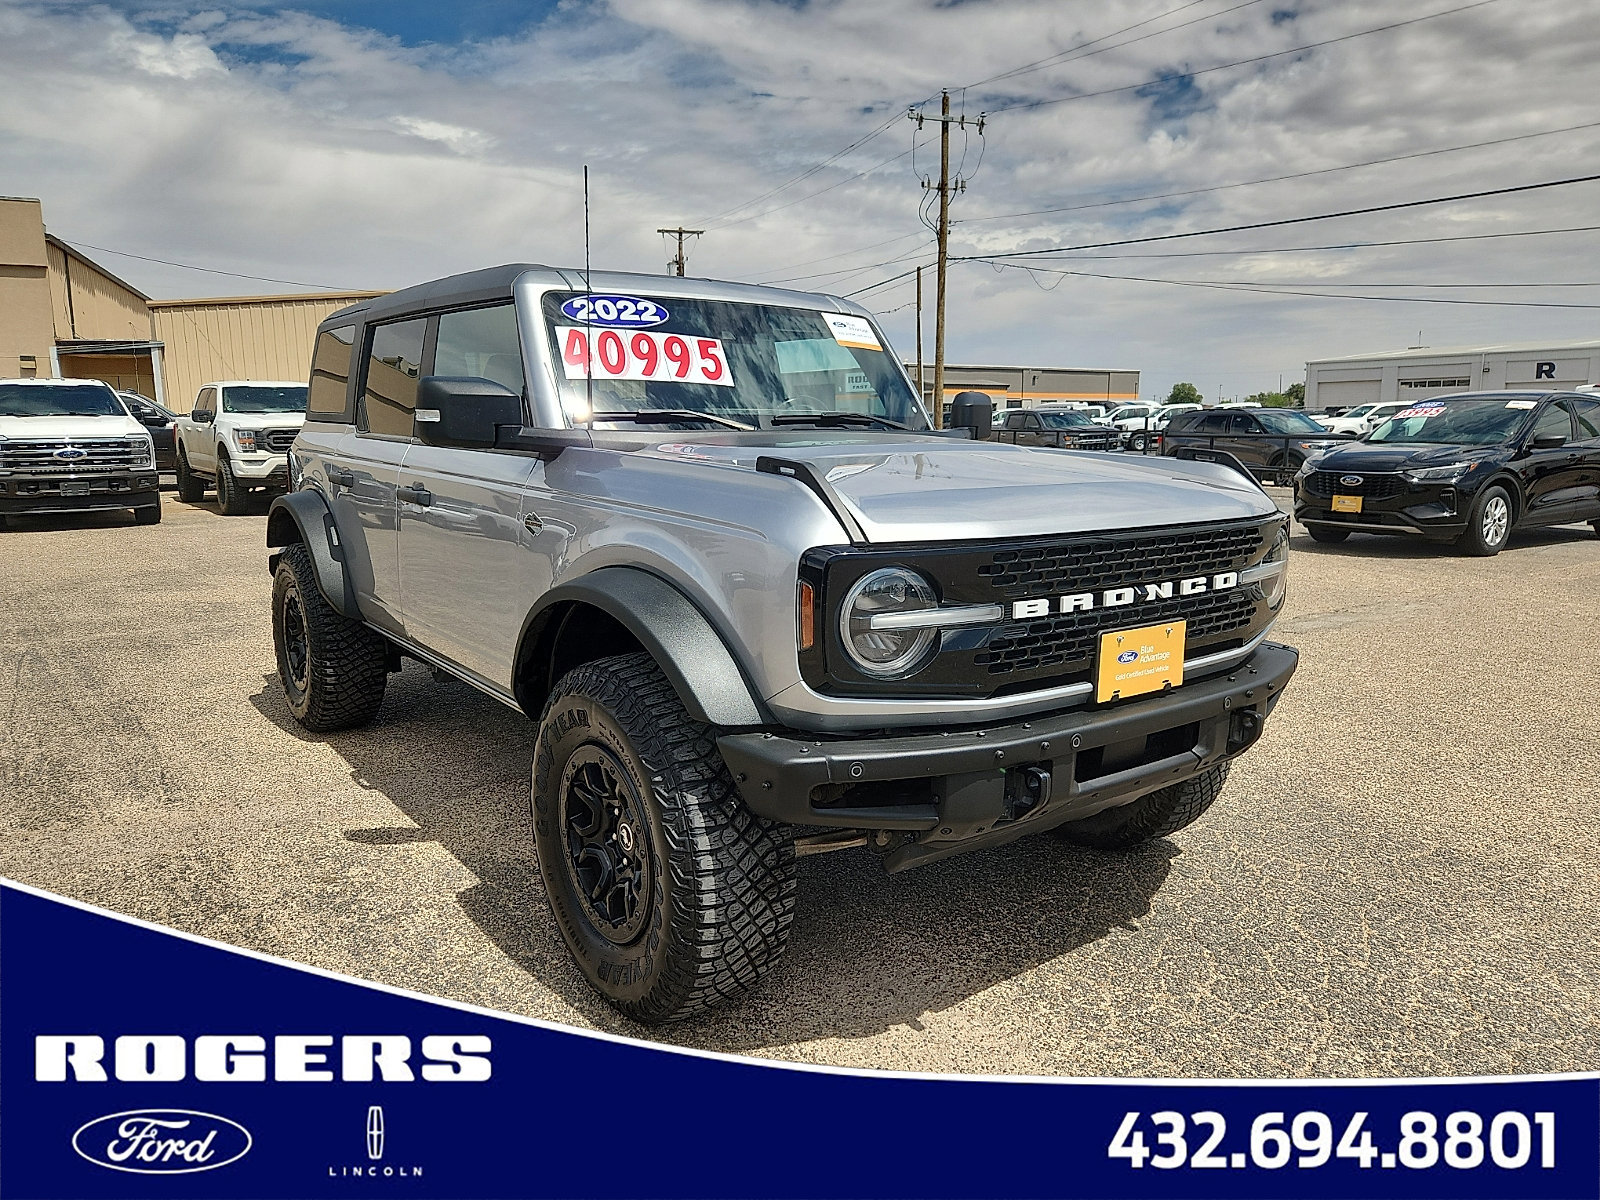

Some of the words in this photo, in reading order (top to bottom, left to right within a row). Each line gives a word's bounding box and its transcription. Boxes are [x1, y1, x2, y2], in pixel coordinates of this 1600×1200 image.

[572, 299, 661, 321] 2022
[564, 328, 724, 381] 40995
[1535, 361, 1556, 379] R
[1012, 571, 1238, 620] BRONCO
[1119, 651, 1136, 663] Ford
[1140, 645, 1154, 654] Blue
[1140, 651, 1170, 663] Advantage
